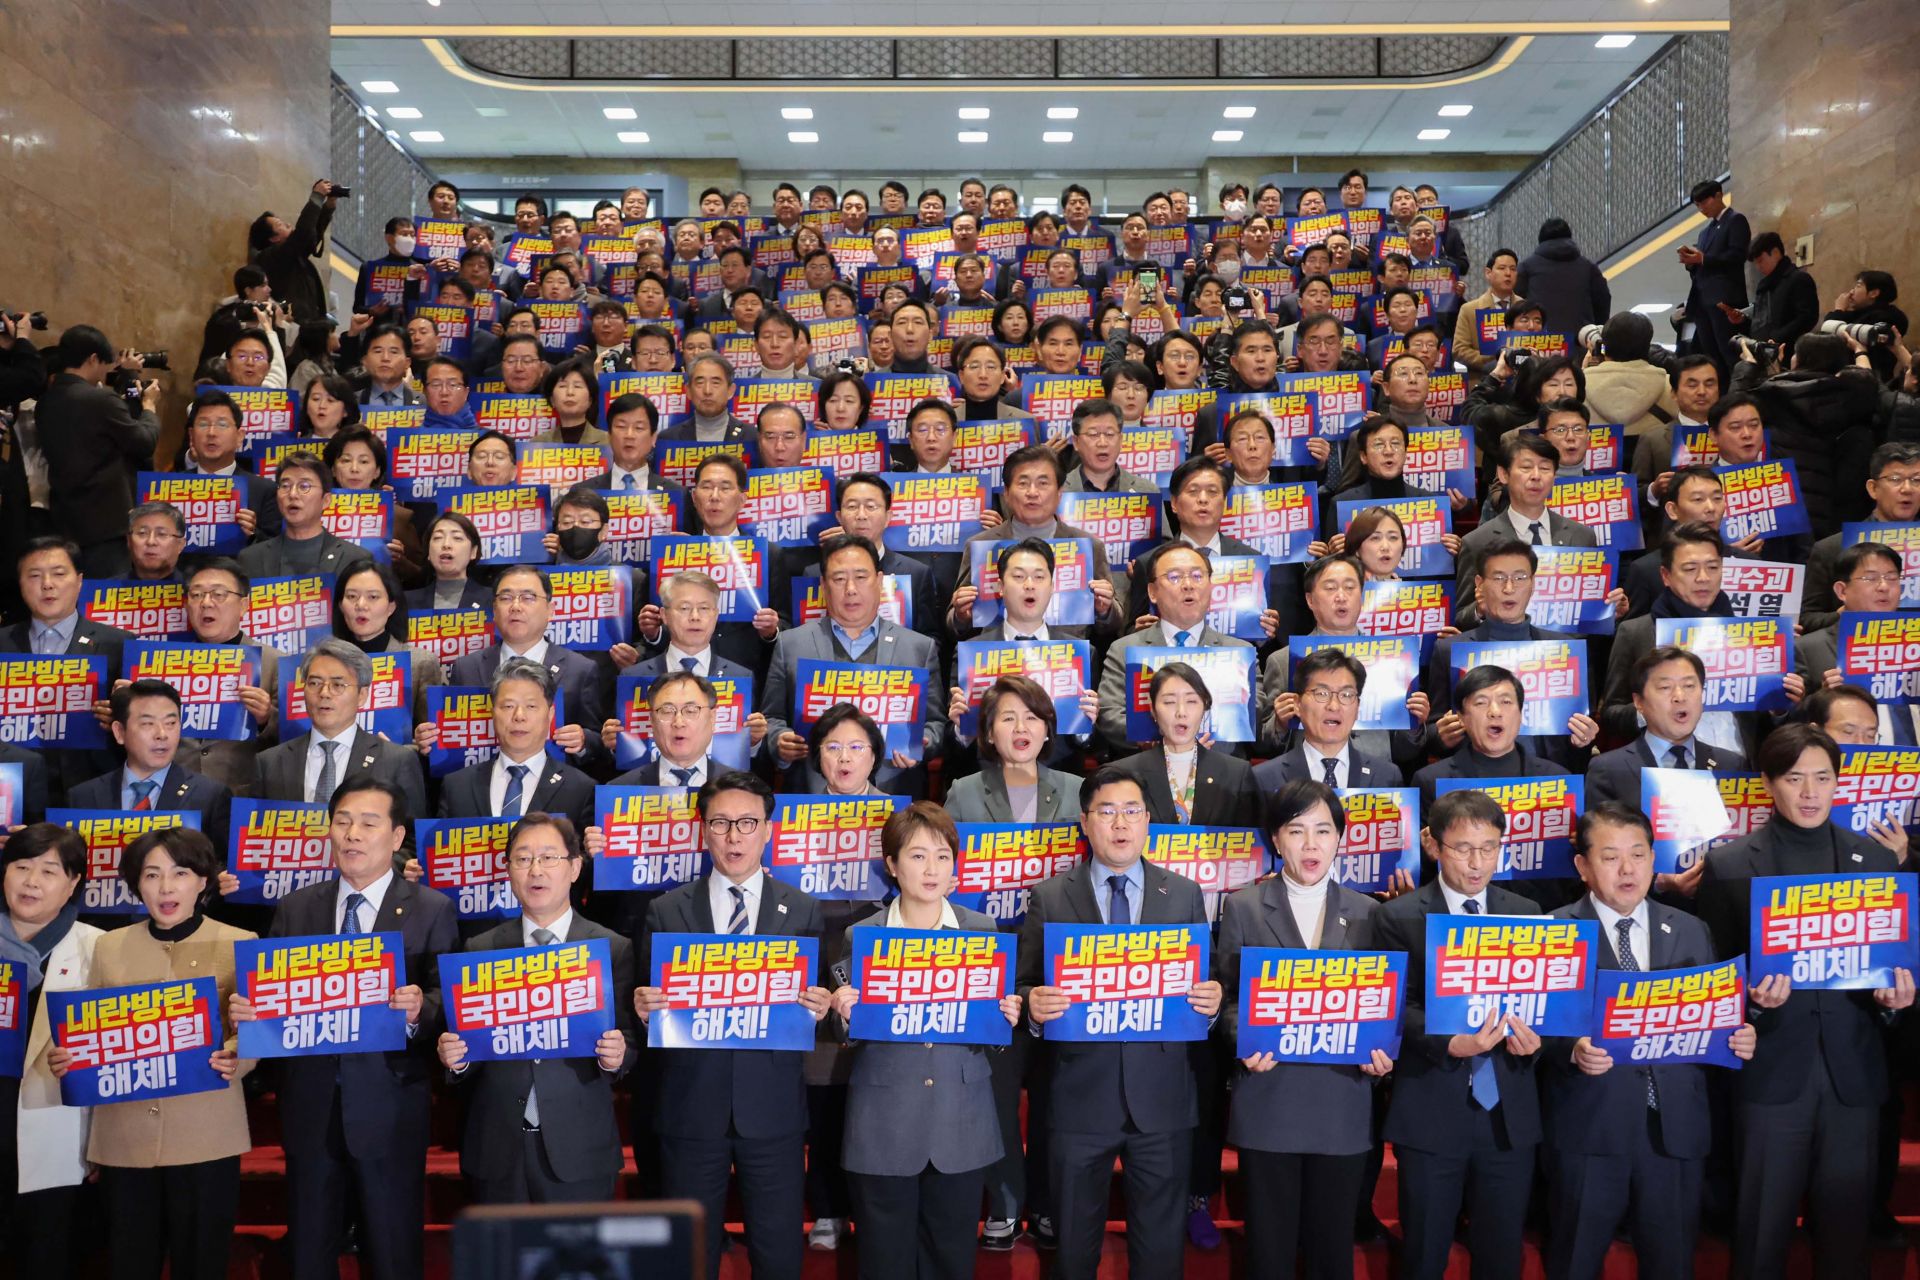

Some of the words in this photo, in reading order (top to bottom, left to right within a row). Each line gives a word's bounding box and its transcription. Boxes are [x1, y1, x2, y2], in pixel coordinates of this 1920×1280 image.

[979, 221, 1025, 234] 내란방탄
[1294, 214, 1342, 231] 내란방탄
[977, 233, 1027, 249] 국민의힘
[1061, 237, 1107, 249] 내란방탄
[865, 267, 913, 283] 내란방탄
[1242, 269, 1292, 282] 내란방탄
[1037, 290, 1088, 305] 내란방탄
[1506, 335, 1564, 350] 내란방탄
[233, 391, 288, 411] 란방탄
[610, 375, 684, 397] 내란방탄
[740, 379, 813, 402] 내란방탄
[874, 377, 948, 398] 내란방탄
[522, 447, 602, 468] 내란방탄
[1404, 448, 1464, 471] 민의힘
[149, 478, 234, 502] 내란방탄
[452, 487, 538, 513] 내란방탄
[606, 491, 670, 516] 란방탄
[893, 476, 979, 501] 내란방탄
[1223, 484, 1305, 516] 내란방탄
[1726, 483, 1791, 515] 민의힘
[740, 490, 827, 518] 국민의힘
[891, 496, 981, 524] 국민의힘
[1063, 494, 1149, 521] 내란방탄
[607, 516, 674, 538] 민의힘
[756, 515, 808, 542] 해체!
[907, 521, 960, 546] 해체!
[1220, 507, 1309, 537] 국민의힘
[664, 539, 755, 566] 내란방탄
[251, 577, 323, 606] 란방탄
[549, 569, 615, 594] 란방탄
[1534, 575, 1605, 600] 민의힘
[1722, 567, 1788, 590] 란수괴
[94, 582, 184, 610] 내란방탄
[550, 590, 621, 619] 민의힘
[139, 649, 245, 674] 내란방탄
[975, 644, 1075, 675] 내란방탄
[1703, 646, 1781, 676] 민의힘
[812, 669, 913, 695] 내란방탄
[0, 713, 67, 743] 해체!
[1841, 751, 1920, 774] 내란방
[1835, 774, 1920, 802] 국민의
[613, 791, 698, 823] 내란방
[781, 799, 895, 832] 내란방탄
[248, 810, 329, 836] 내란방
[609, 820, 708, 854] 국민의
[243, 838, 335, 869] 국민의
[435, 822, 516, 856] 내란방
[965, 825, 1080, 861] 내란방탄
[1142, 831, 1255, 860] 내란방탄
[631, 853, 701, 884] 해체!
[800, 861, 870, 894] 해체!
[1770, 878, 1898, 917] 내란방탄
[1447, 924, 1578, 957] 내란방탄
[1766, 908, 1900, 951] 국민의힘
[256, 938, 385, 982] 내란방탄
[671, 940, 800, 974] 내란방탄
[872, 937, 998, 969] 내란방탄
[1064, 929, 1191, 966] 내란방탄
[460, 944, 591, 994] 내란방탄
[1260, 954, 1389, 990] 내란방탄
[1442, 954, 1580, 993] 국민의힘
[1791, 946, 1870, 982] 해체!
[255, 969, 390, 1016] 국민의힘
[667, 969, 802, 1007] 국민의힘
[868, 966, 1000, 1002] 국민의힘
[1060, 961, 1194, 999] 국민의힘
[1617, 964, 1737, 1008] 내란방탄
[66, 983, 196, 1034] 내란방탄
[459, 975, 598, 1030] 국민의힘
[1085, 997, 1164, 1034] 해체!
[1255, 986, 1389, 1024] 국민의힘
[1610, 995, 1741, 1037] 국민의힘
[282, 1016, 361, 1050] 해체!
[691, 1005, 769, 1041] 해체!
[891, 1001, 966, 1035] 해체!
[66, 1014, 205, 1066] 국민의힘
[491, 1018, 570, 1056] 해체!
[1279, 1020, 1358, 1056] 해체!
[1631, 1029, 1709, 1061] 해체!
[98, 1060, 178, 1098] 해체!
